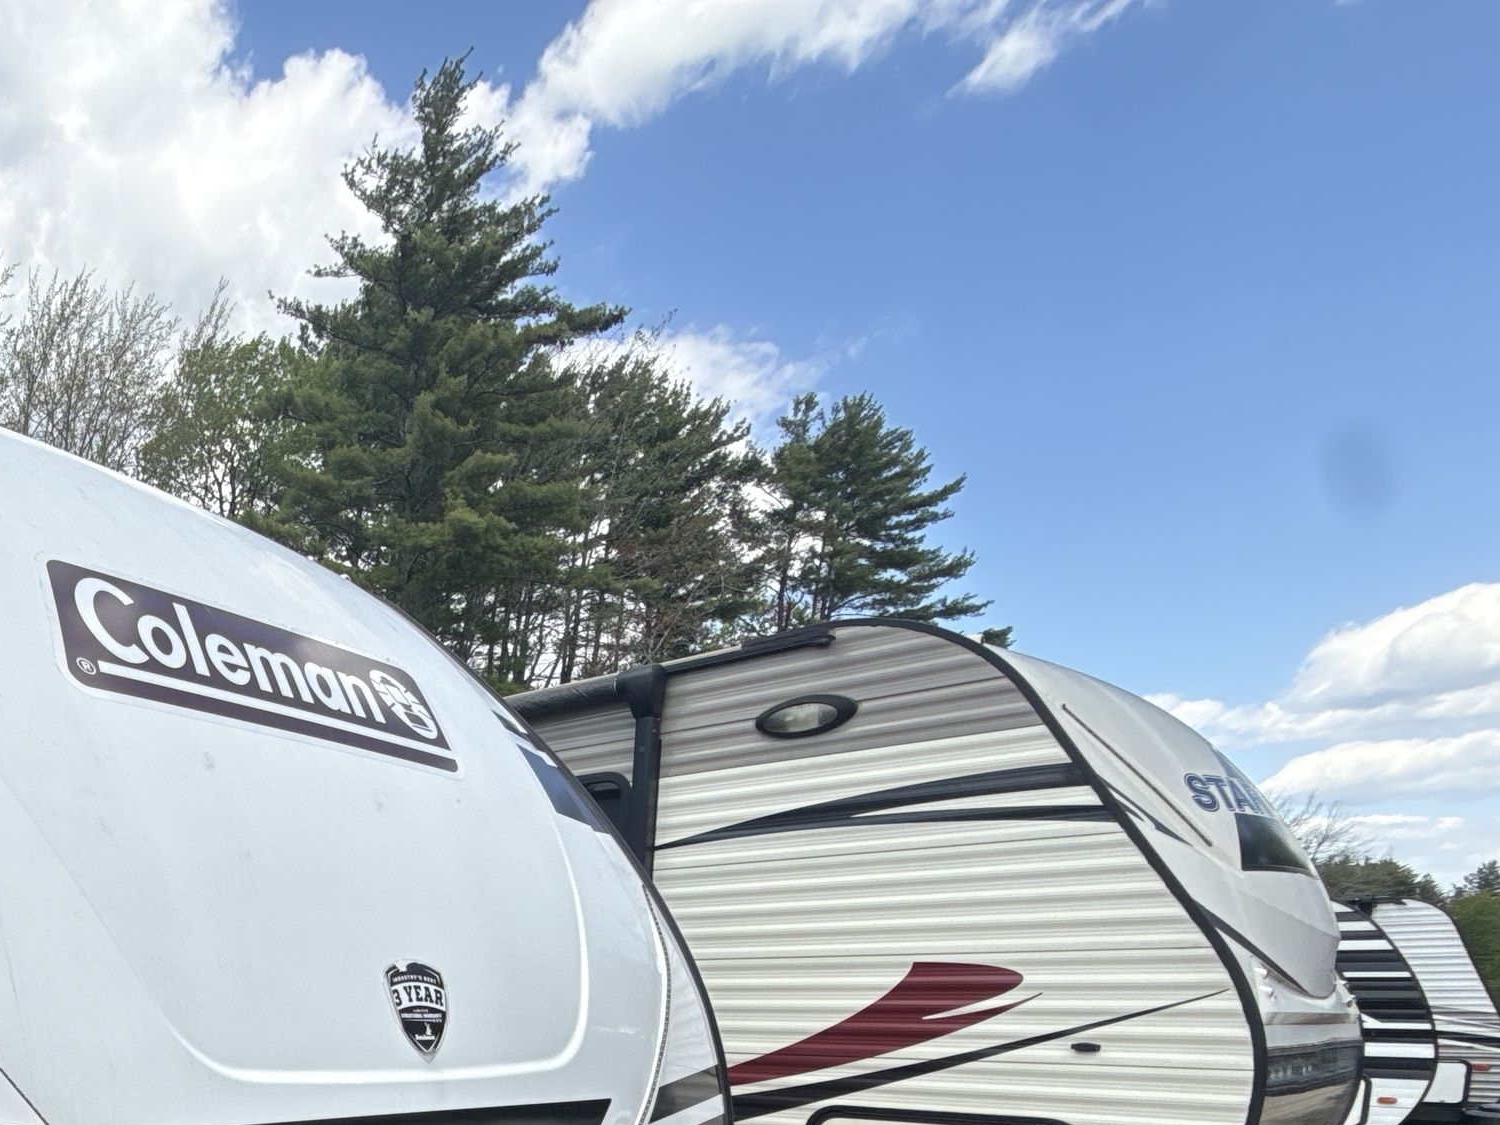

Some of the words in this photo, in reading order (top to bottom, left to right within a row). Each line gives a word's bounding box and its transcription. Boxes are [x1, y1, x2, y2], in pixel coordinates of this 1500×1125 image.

[74, 577, 387, 724] Coleman
[392, 988, 403, 1007] 3
[403, 984, 444, 1007] YEAR
